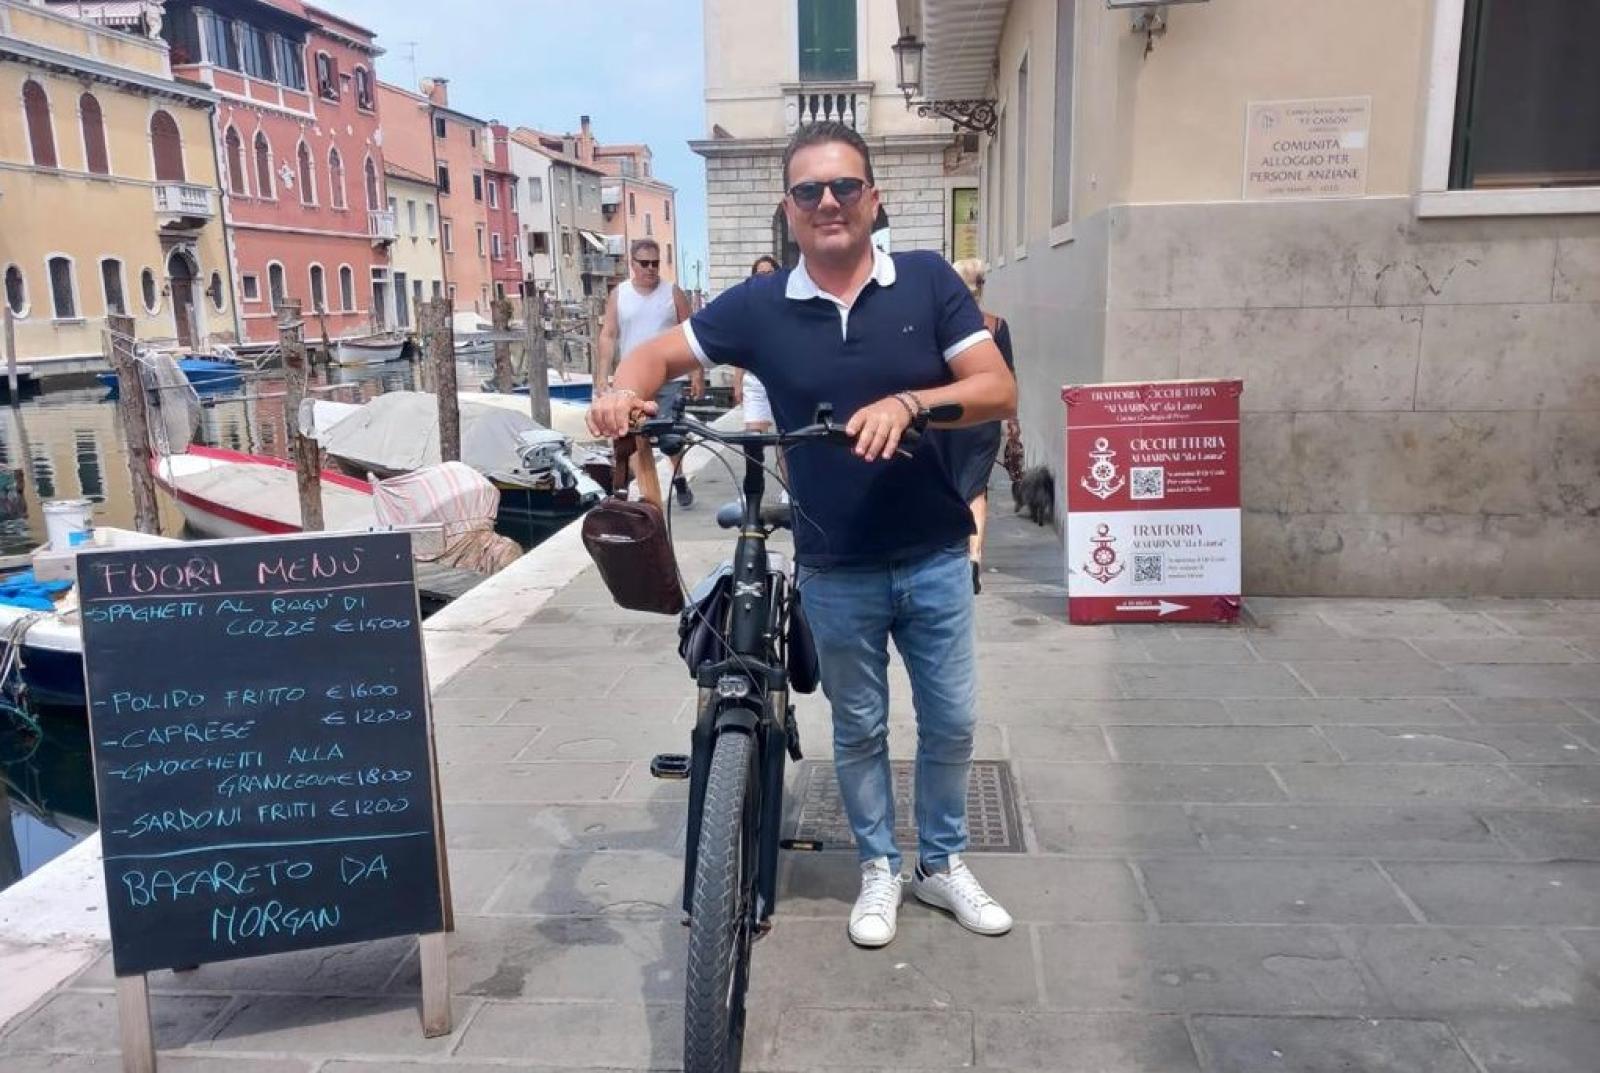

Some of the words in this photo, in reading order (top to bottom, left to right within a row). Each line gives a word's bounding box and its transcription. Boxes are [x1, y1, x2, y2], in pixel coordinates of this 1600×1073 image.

[1261, 155, 1325, 167] ALLOGGIO
[1328, 154, 1350, 165] PER
[1249, 171, 1302, 183] PERSONE
[1129, 435, 1226, 452] CICCHETTERIA
[1132, 523, 1204, 538] TRATTORIA
[94, 555, 222, 594] FUORI
[215, 598, 254, 615] AL
[343, 595, 366, 613] DI
[226, 616, 317, 638] COZZE
[223, 685, 307, 709] FRITTO
[286, 742, 345, 764] ALLA
[258, 800, 317, 825] FRITTI
[121, 860, 314, 907] BACARETO
[339, 853, 389, 887] DA
[211, 899, 342, 945] MORGAN
